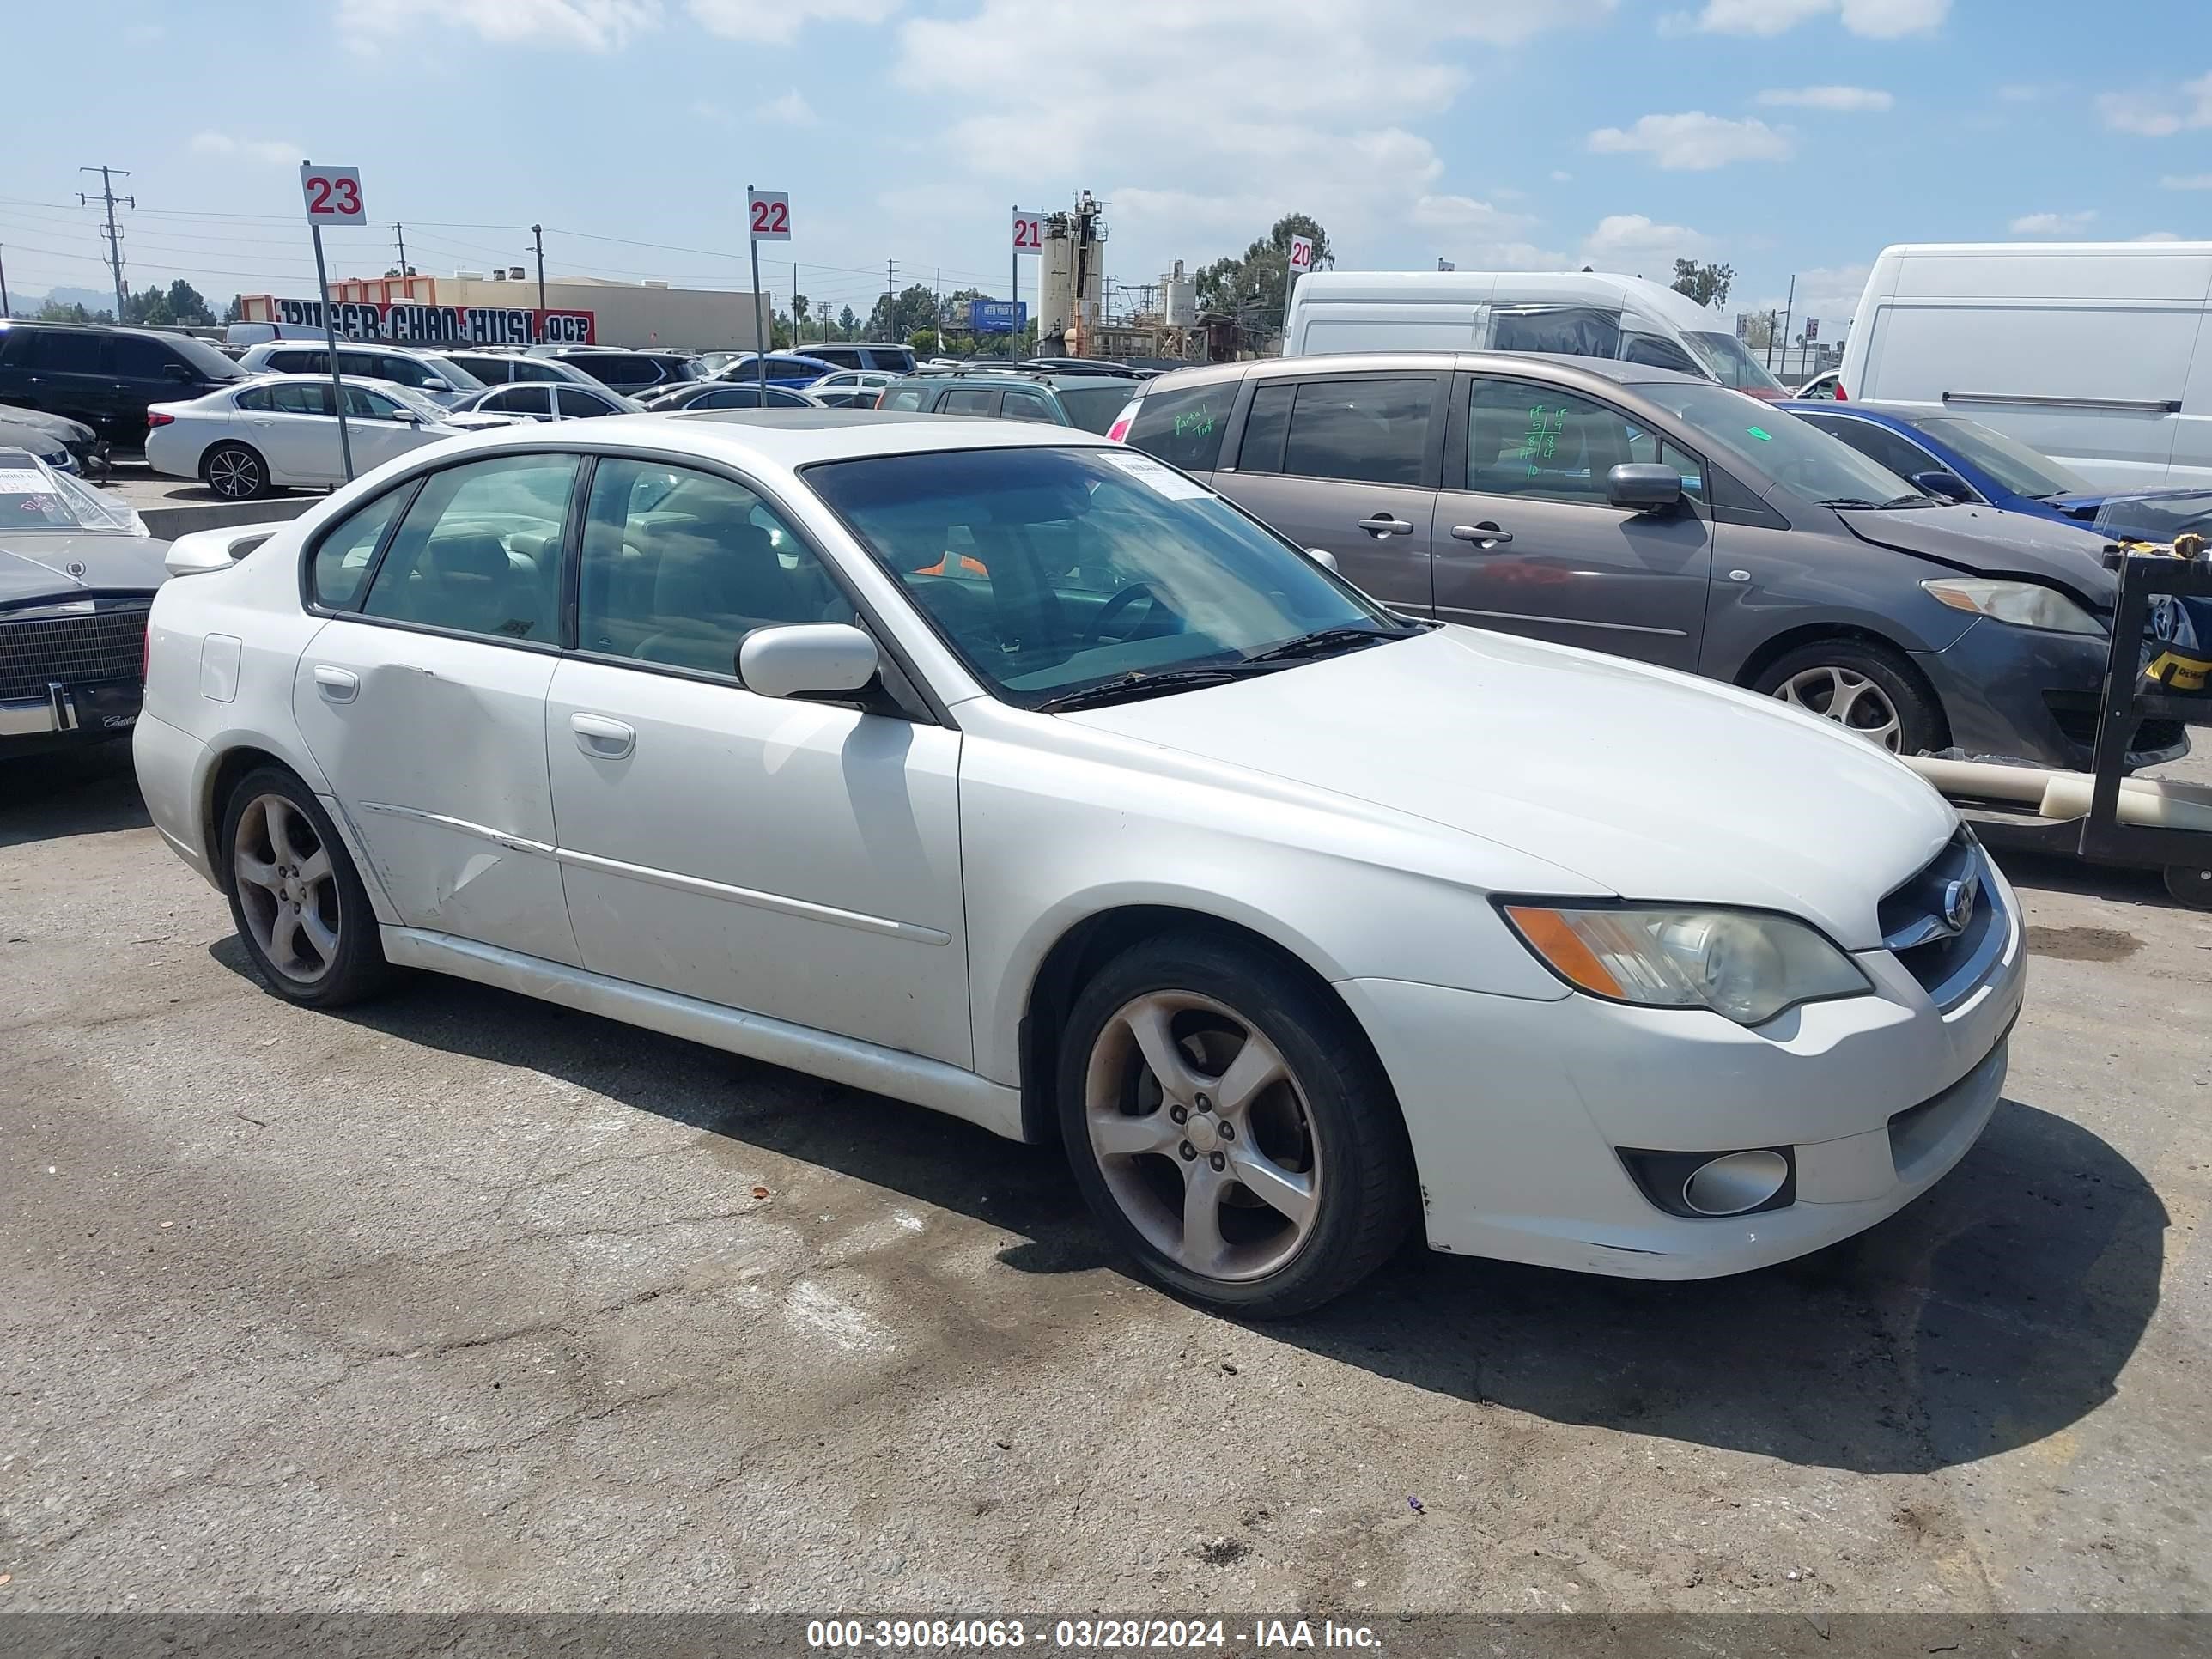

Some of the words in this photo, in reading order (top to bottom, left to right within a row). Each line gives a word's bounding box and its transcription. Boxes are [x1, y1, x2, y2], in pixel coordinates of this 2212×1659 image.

[307, 177, 362, 215] 23
[751, 201, 788, 232] 22
[1014, 219, 1042, 248] 21
[1291, 242, 1310, 267] 20
[547, 314, 590, 343] OCP
[1738, 319, 1747, 333] 16
[1806, 323, 1818, 337] 15
[1528, 435, 1535, 447] 8
[1547, 435, 1554, 447] 8
